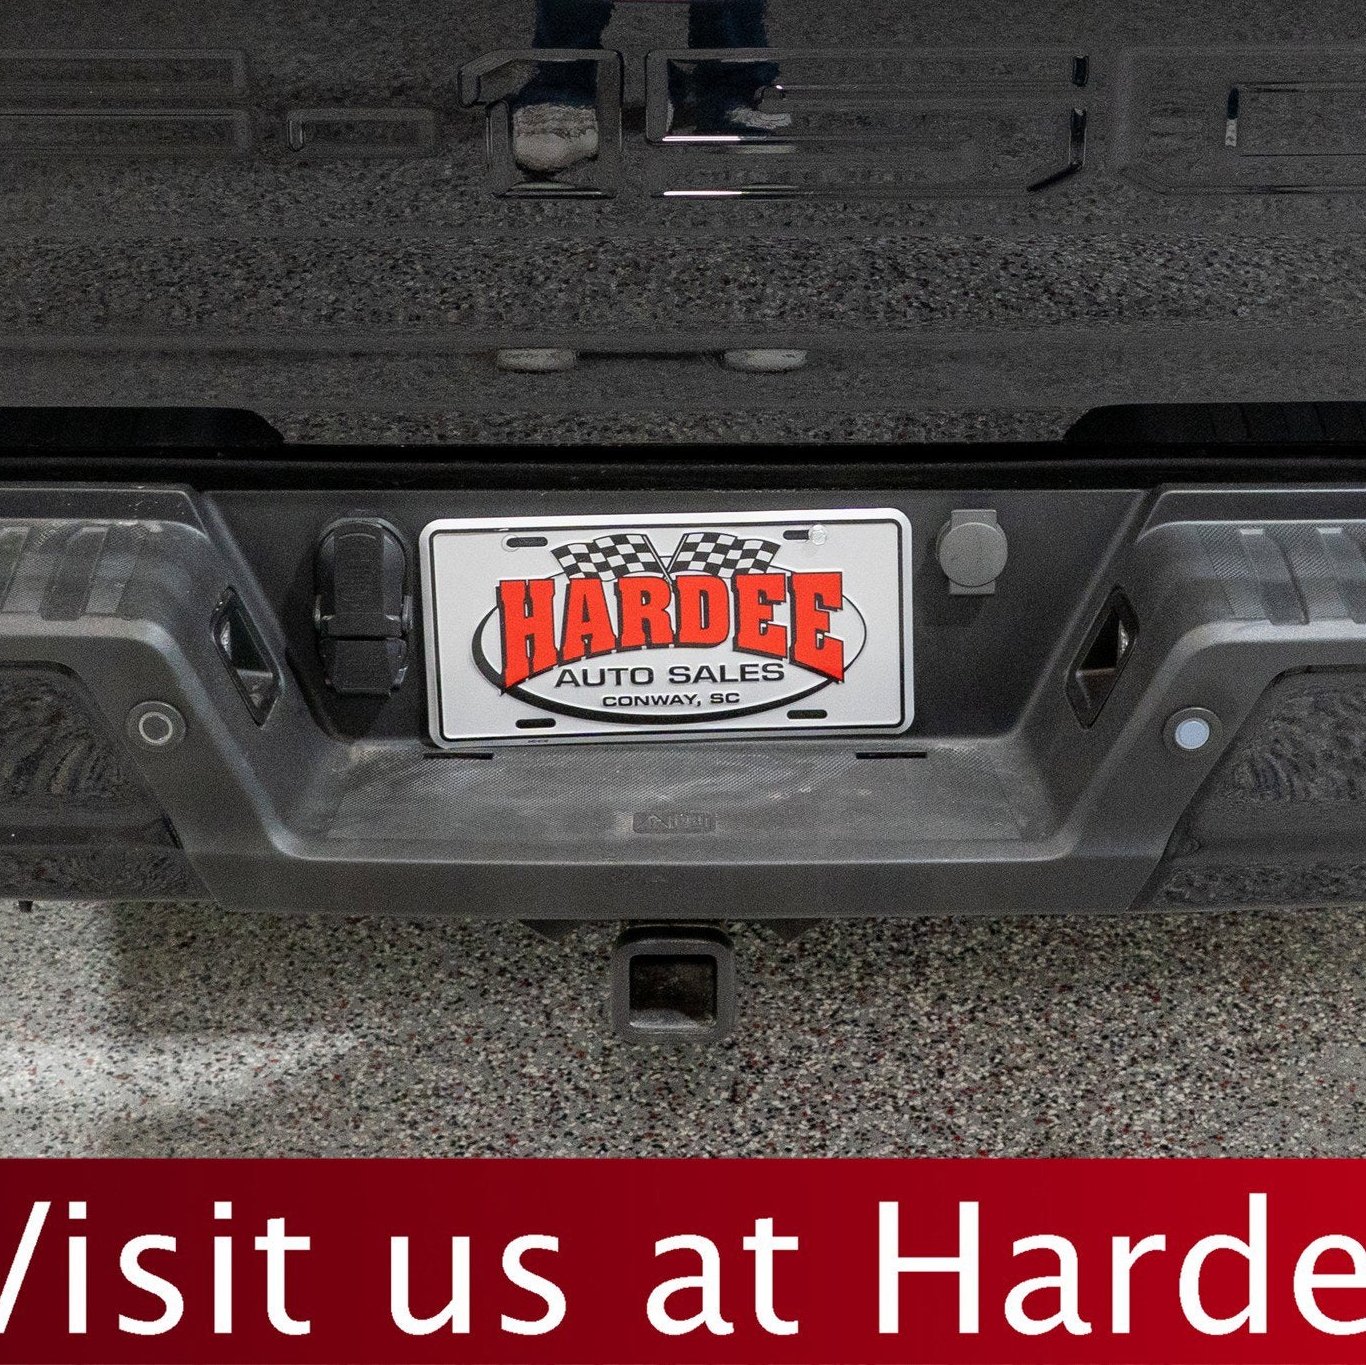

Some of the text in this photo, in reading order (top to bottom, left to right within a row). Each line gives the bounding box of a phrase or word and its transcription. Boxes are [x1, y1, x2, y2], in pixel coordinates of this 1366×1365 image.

[496, 571, 845, 695] HARDEE
[554, 662, 786, 688] AUTO SALES
[602, 691, 741, 708] CONWAY, SC
